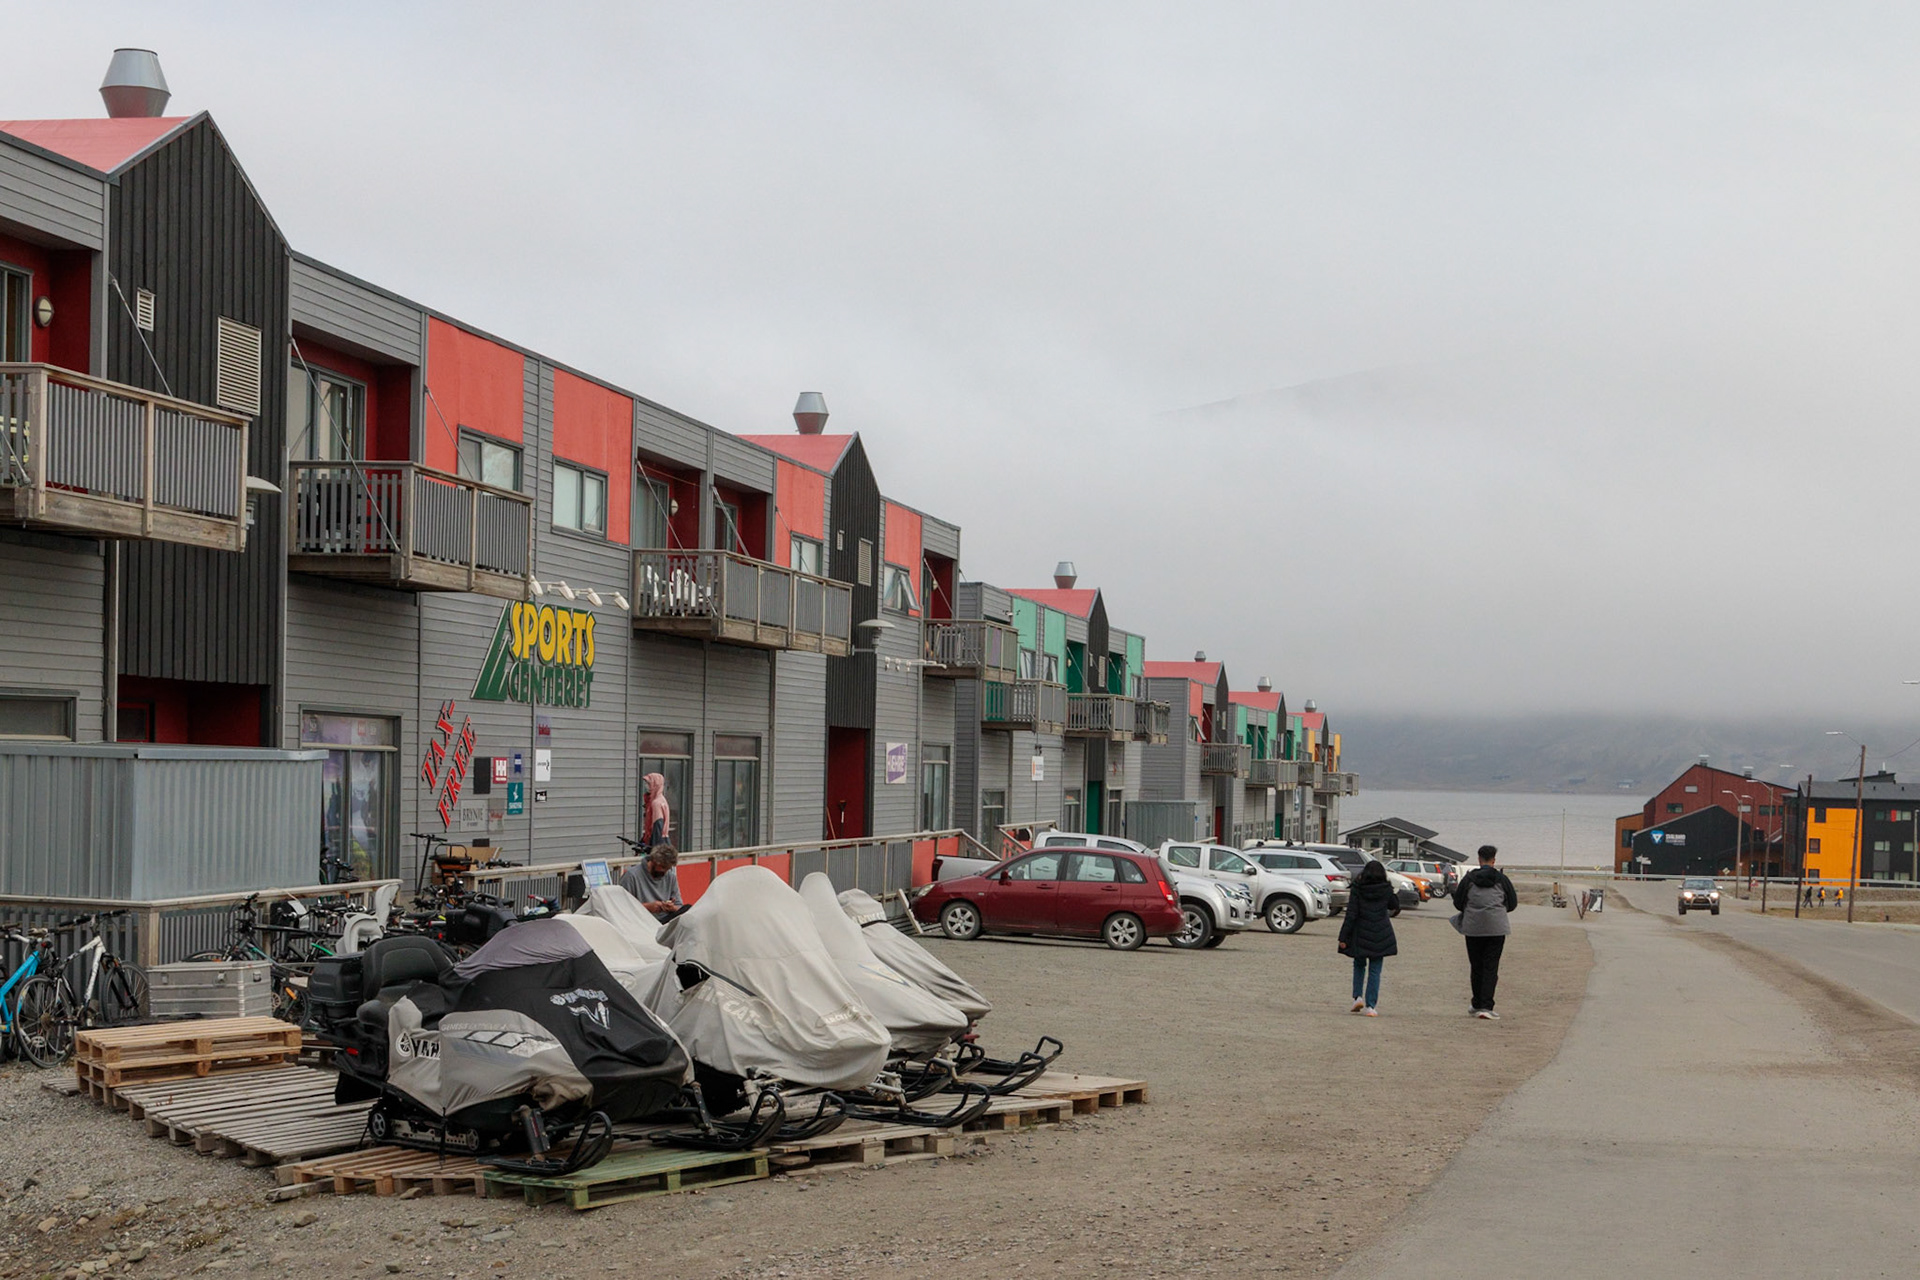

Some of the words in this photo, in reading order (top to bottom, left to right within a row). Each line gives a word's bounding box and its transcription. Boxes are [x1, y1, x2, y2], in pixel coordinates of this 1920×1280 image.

[511, 600, 596, 668] SPORTS
[508, 660, 594, 708] CENTERET
[421, 699, 455, 793] TAX
[437, 715, 477, 829] FREE
